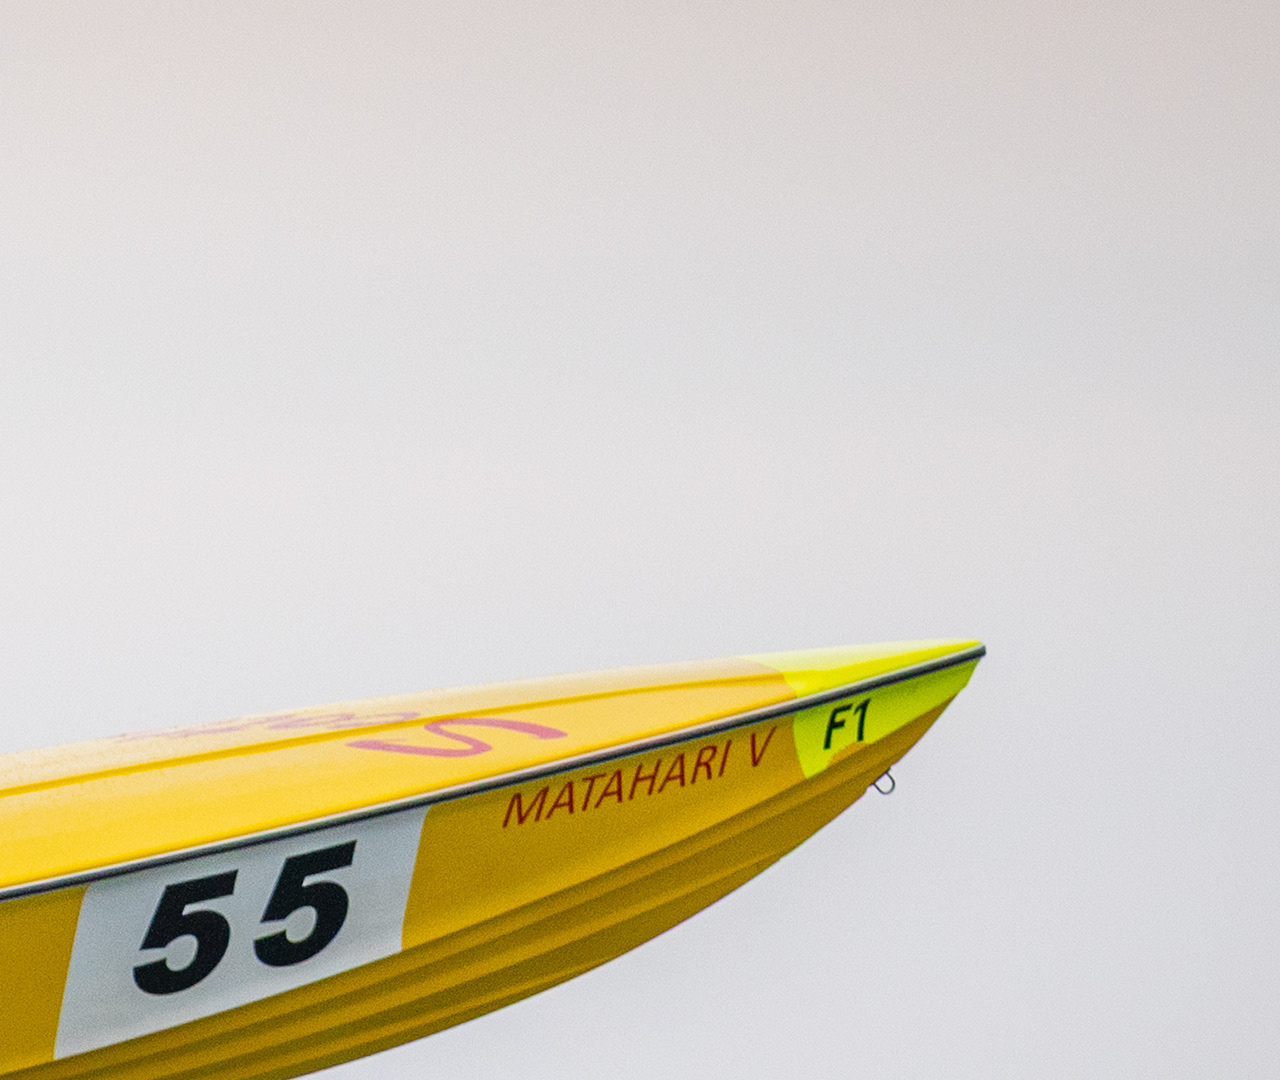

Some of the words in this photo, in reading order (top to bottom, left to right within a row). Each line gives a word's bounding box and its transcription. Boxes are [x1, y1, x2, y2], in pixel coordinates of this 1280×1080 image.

[823, 698, 871, 751] F1
[502, 740, 732, 829] MATAHARI
[749, 726, 777, 768] V
[131, 840, 357, 995] 55
